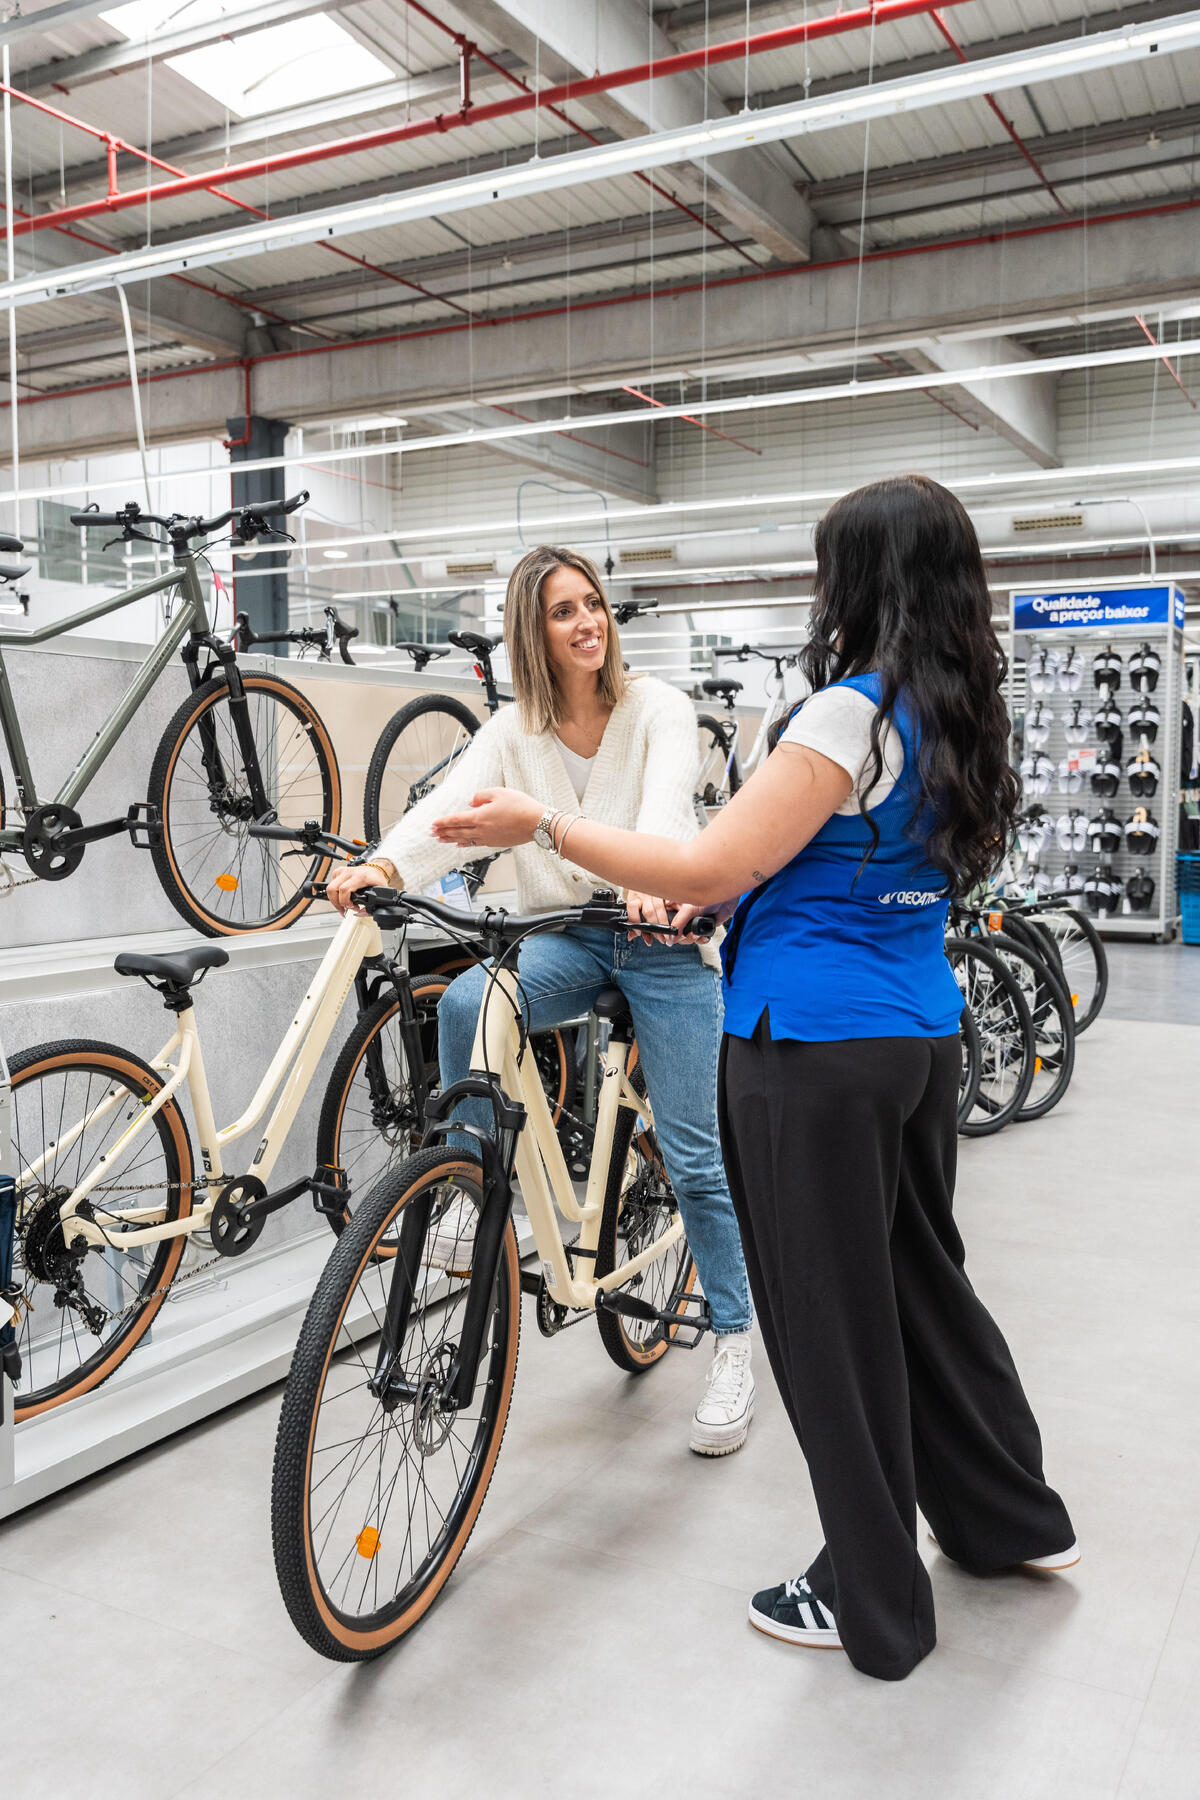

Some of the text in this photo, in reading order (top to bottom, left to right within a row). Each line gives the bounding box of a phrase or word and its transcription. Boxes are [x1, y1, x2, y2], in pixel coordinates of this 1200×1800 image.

[1032, 595, 1100, 613] Qualidade
[1049, 605, 1149, 624] a preços baixos
